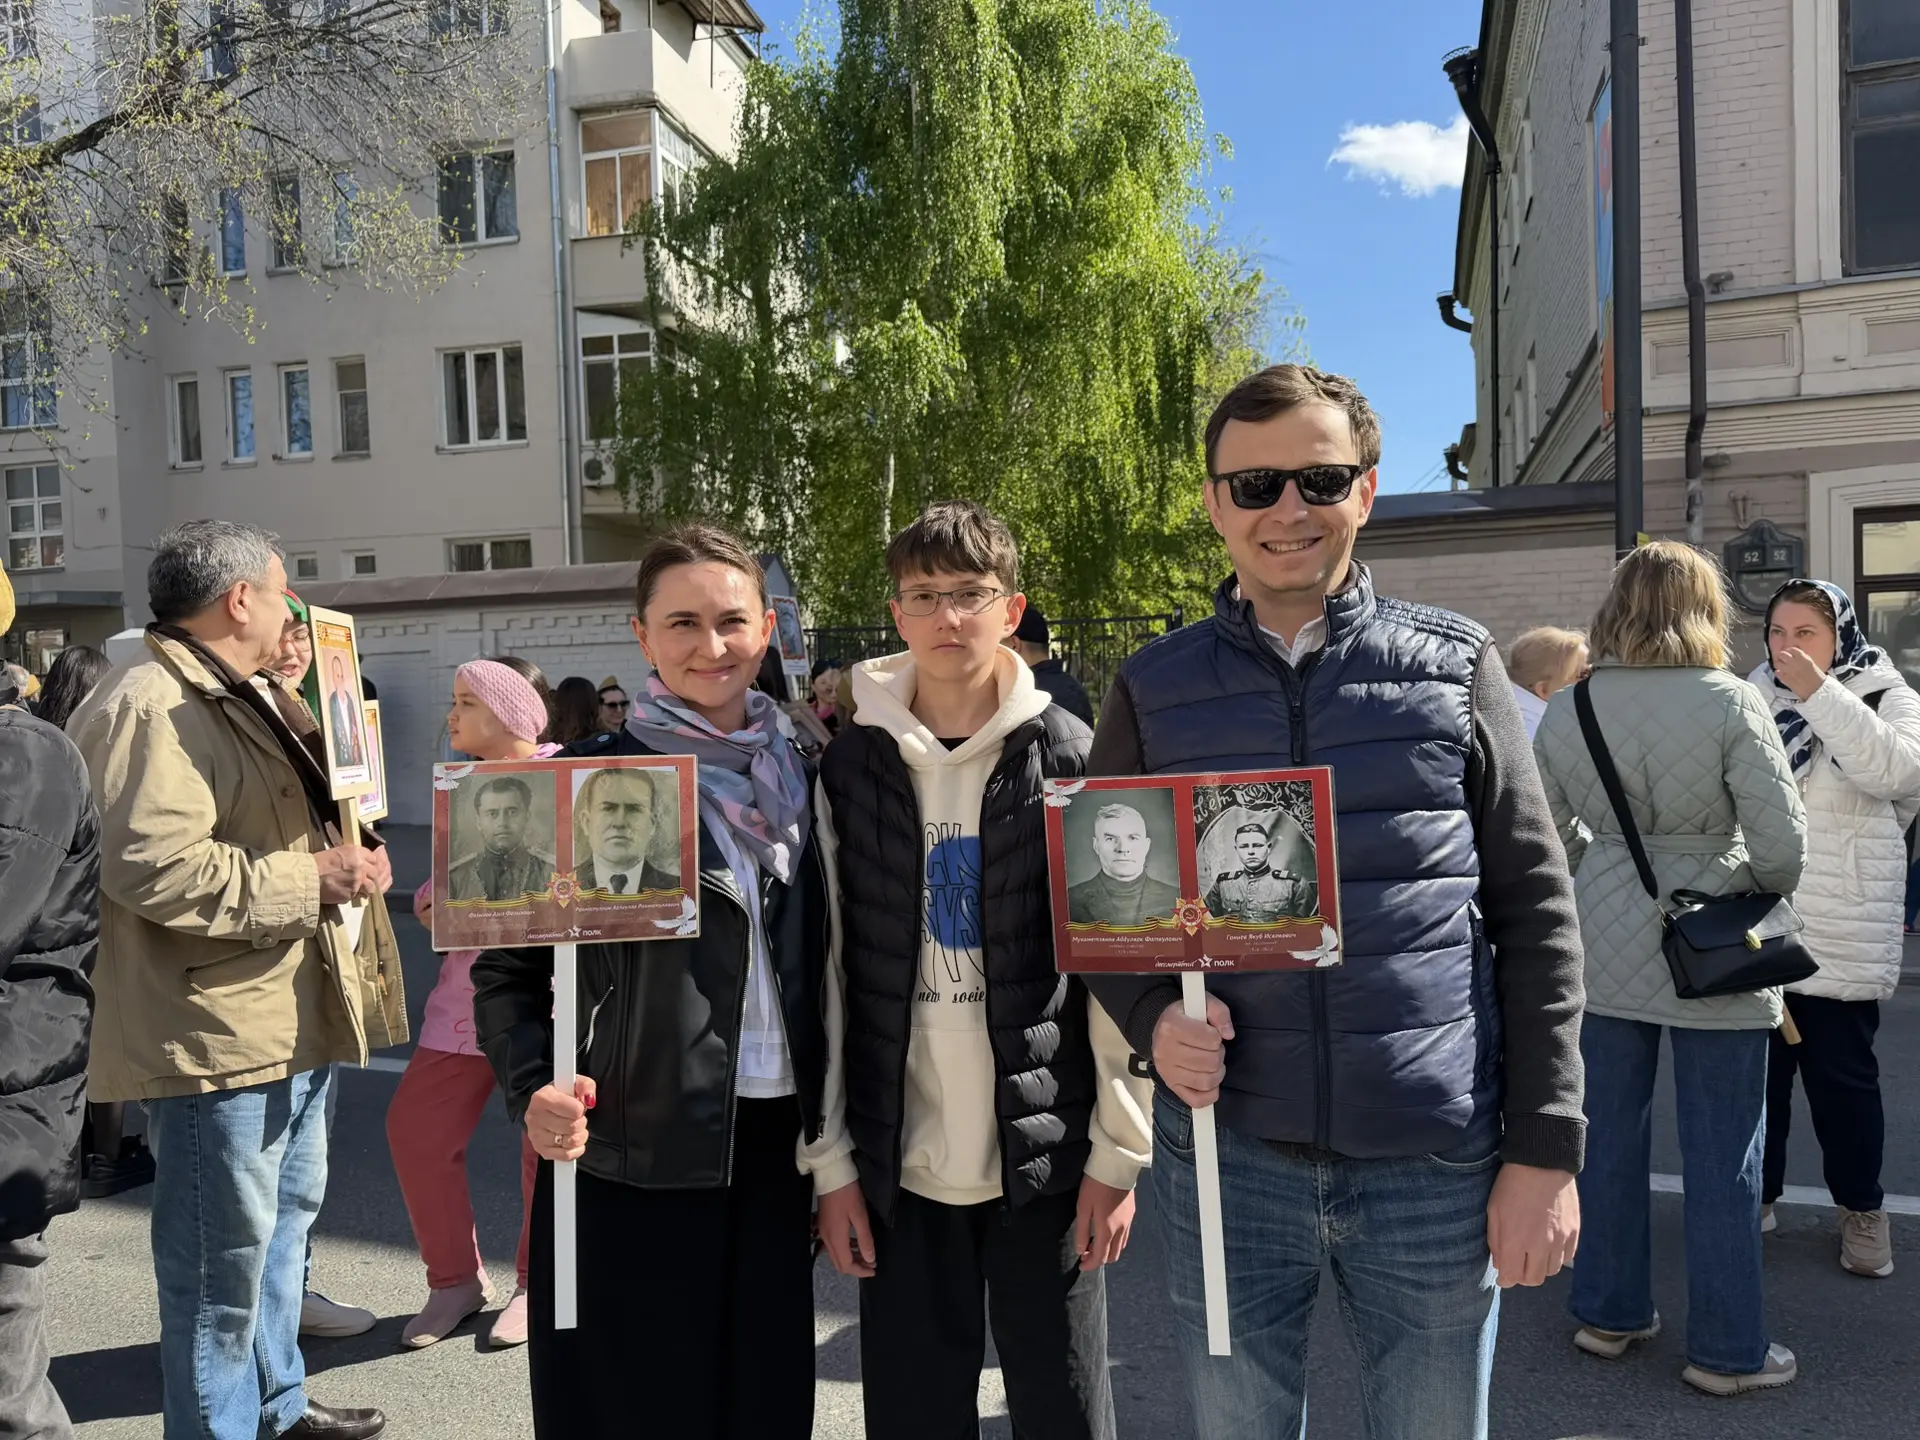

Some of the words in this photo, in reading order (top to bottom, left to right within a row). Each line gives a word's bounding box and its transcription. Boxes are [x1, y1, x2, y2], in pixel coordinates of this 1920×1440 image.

[1744, 551, 1759, 562] 52
[1773, 550, 1786, 560] 52
[918, 991, 940, 1003] new
